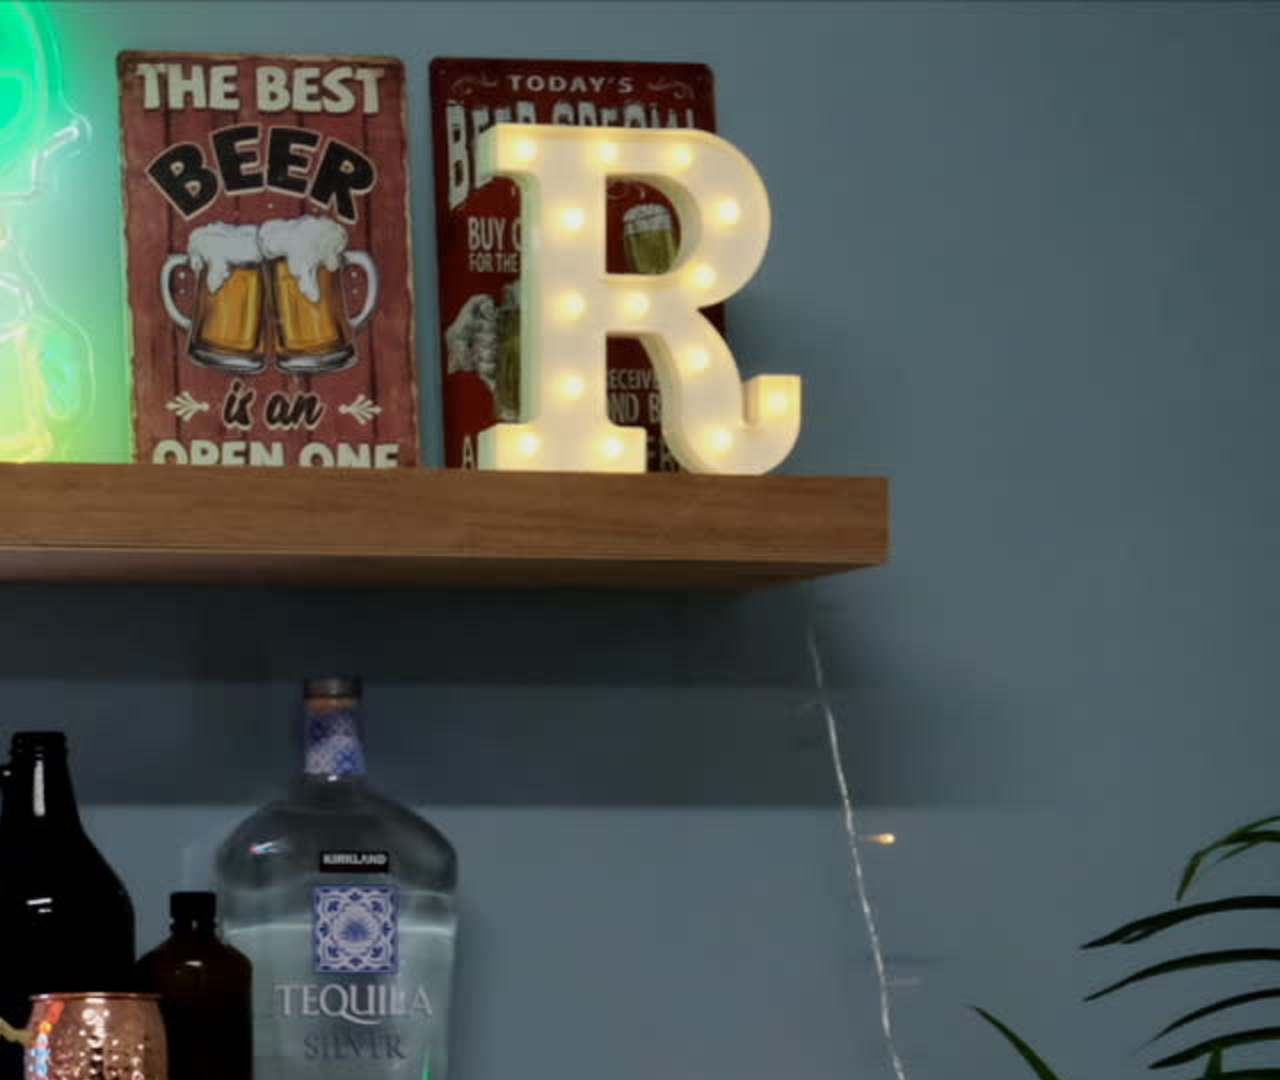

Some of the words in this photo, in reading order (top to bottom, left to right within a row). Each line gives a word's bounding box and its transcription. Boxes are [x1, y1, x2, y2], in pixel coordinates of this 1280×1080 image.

[136, 64, 239, 111] THE
[256, 67, 385, 113] BEST
[507, 73, 634, 93] TODAY'S
[145, 124, 377, 223] BEER
[468, 217, 506, 250] BUY
[468, 253, 493, 272] FOR
[223, 379, 252, 429] is
[266, 393, 324, 430] an
[274, 983, 433, 1025] TEQUILA
[304, 1032, 407, 1061] SILVER
